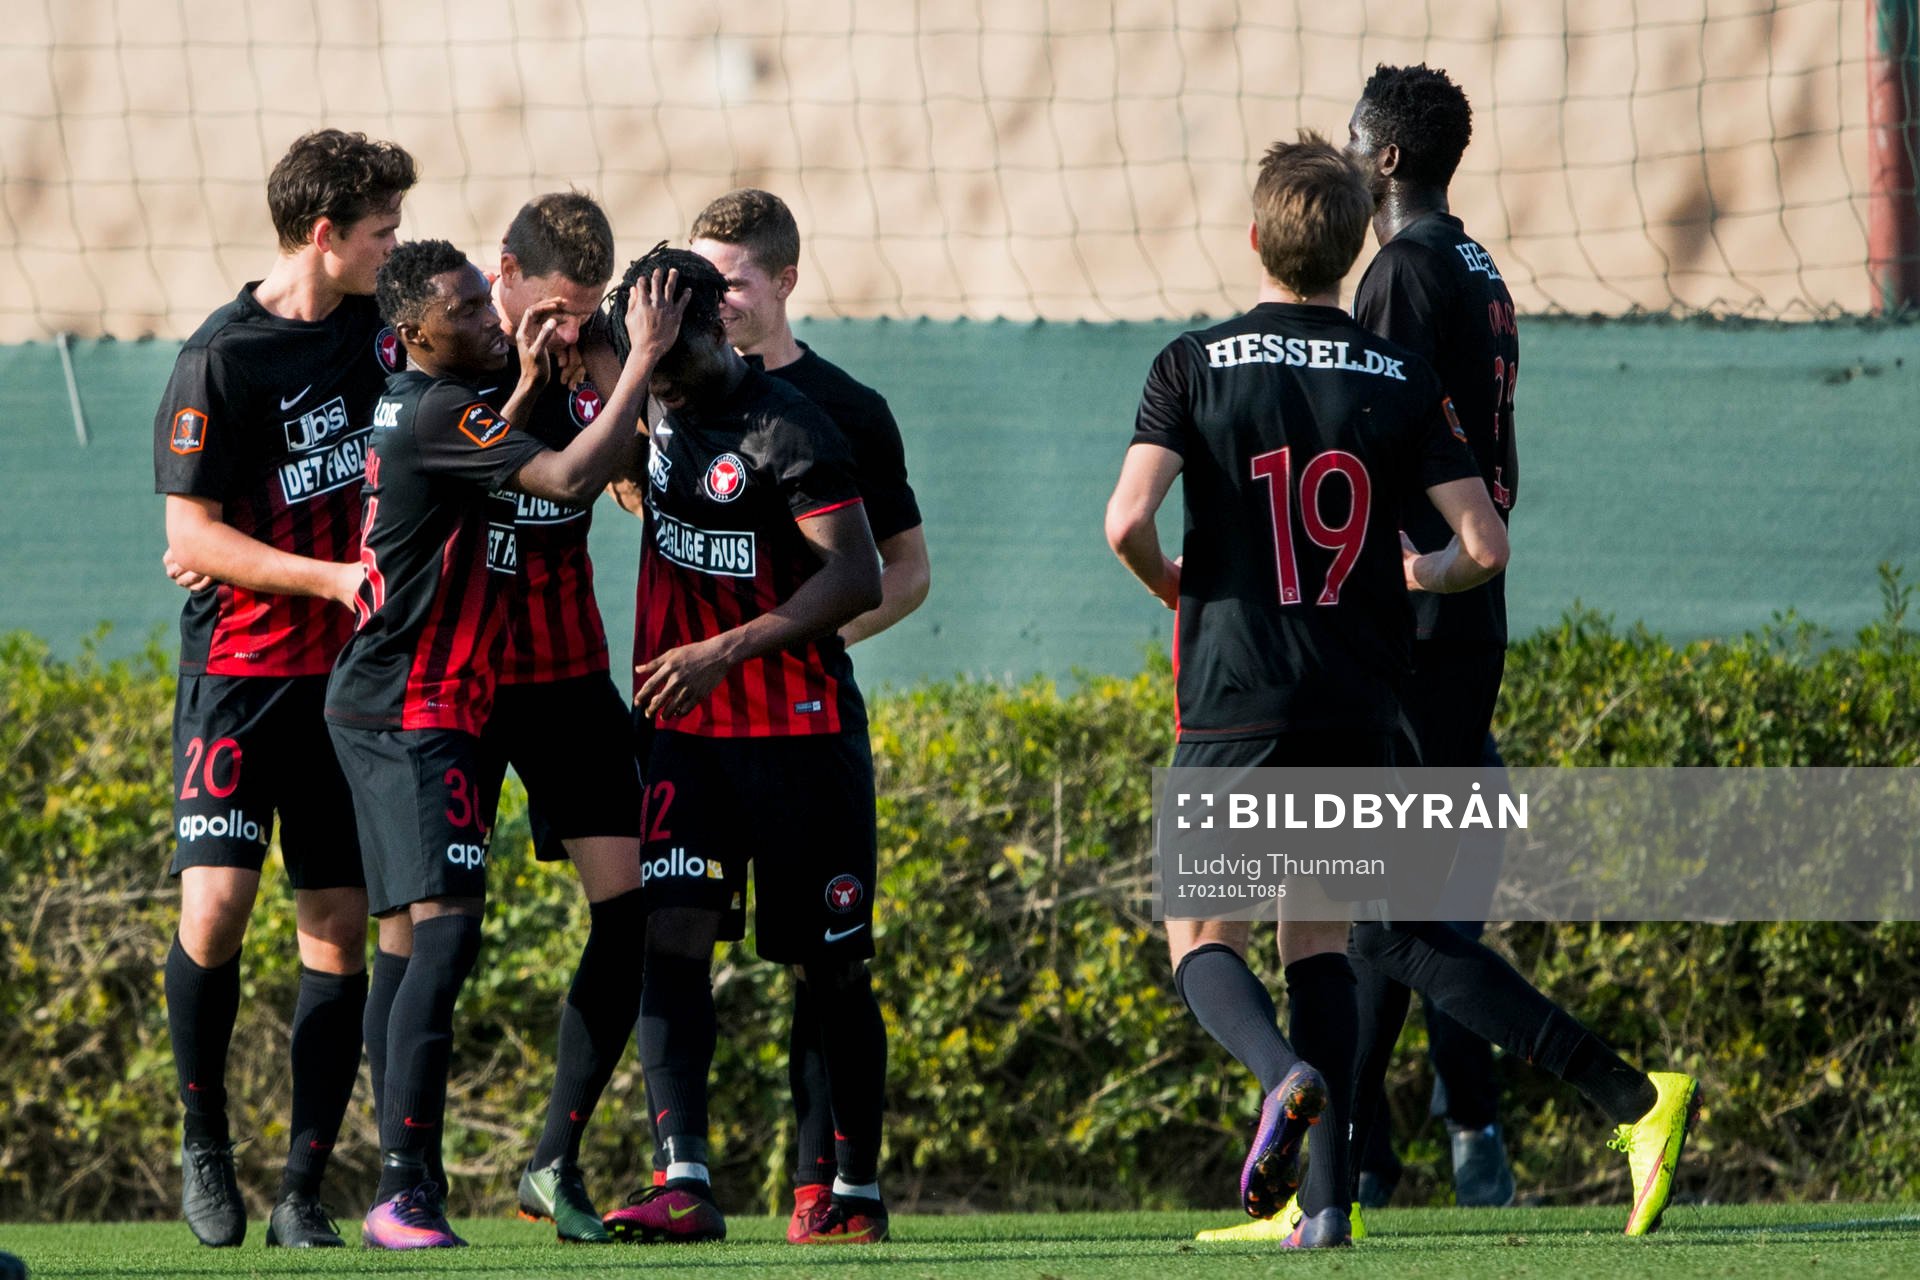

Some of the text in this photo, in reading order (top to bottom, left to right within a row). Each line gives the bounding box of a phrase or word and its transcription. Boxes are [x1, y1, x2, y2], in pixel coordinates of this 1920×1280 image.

[1205, 333, 1407, 381] HESSEL.DK
[290, 406, 347, 449] jbs
[284, 456, 323, 496] DET
[1251, 446, 1372, 605] 19
[710, 537, 750, 570] HUS
[180, 737, 242, 800] 20
[179, 809, 259, 842] apollo
